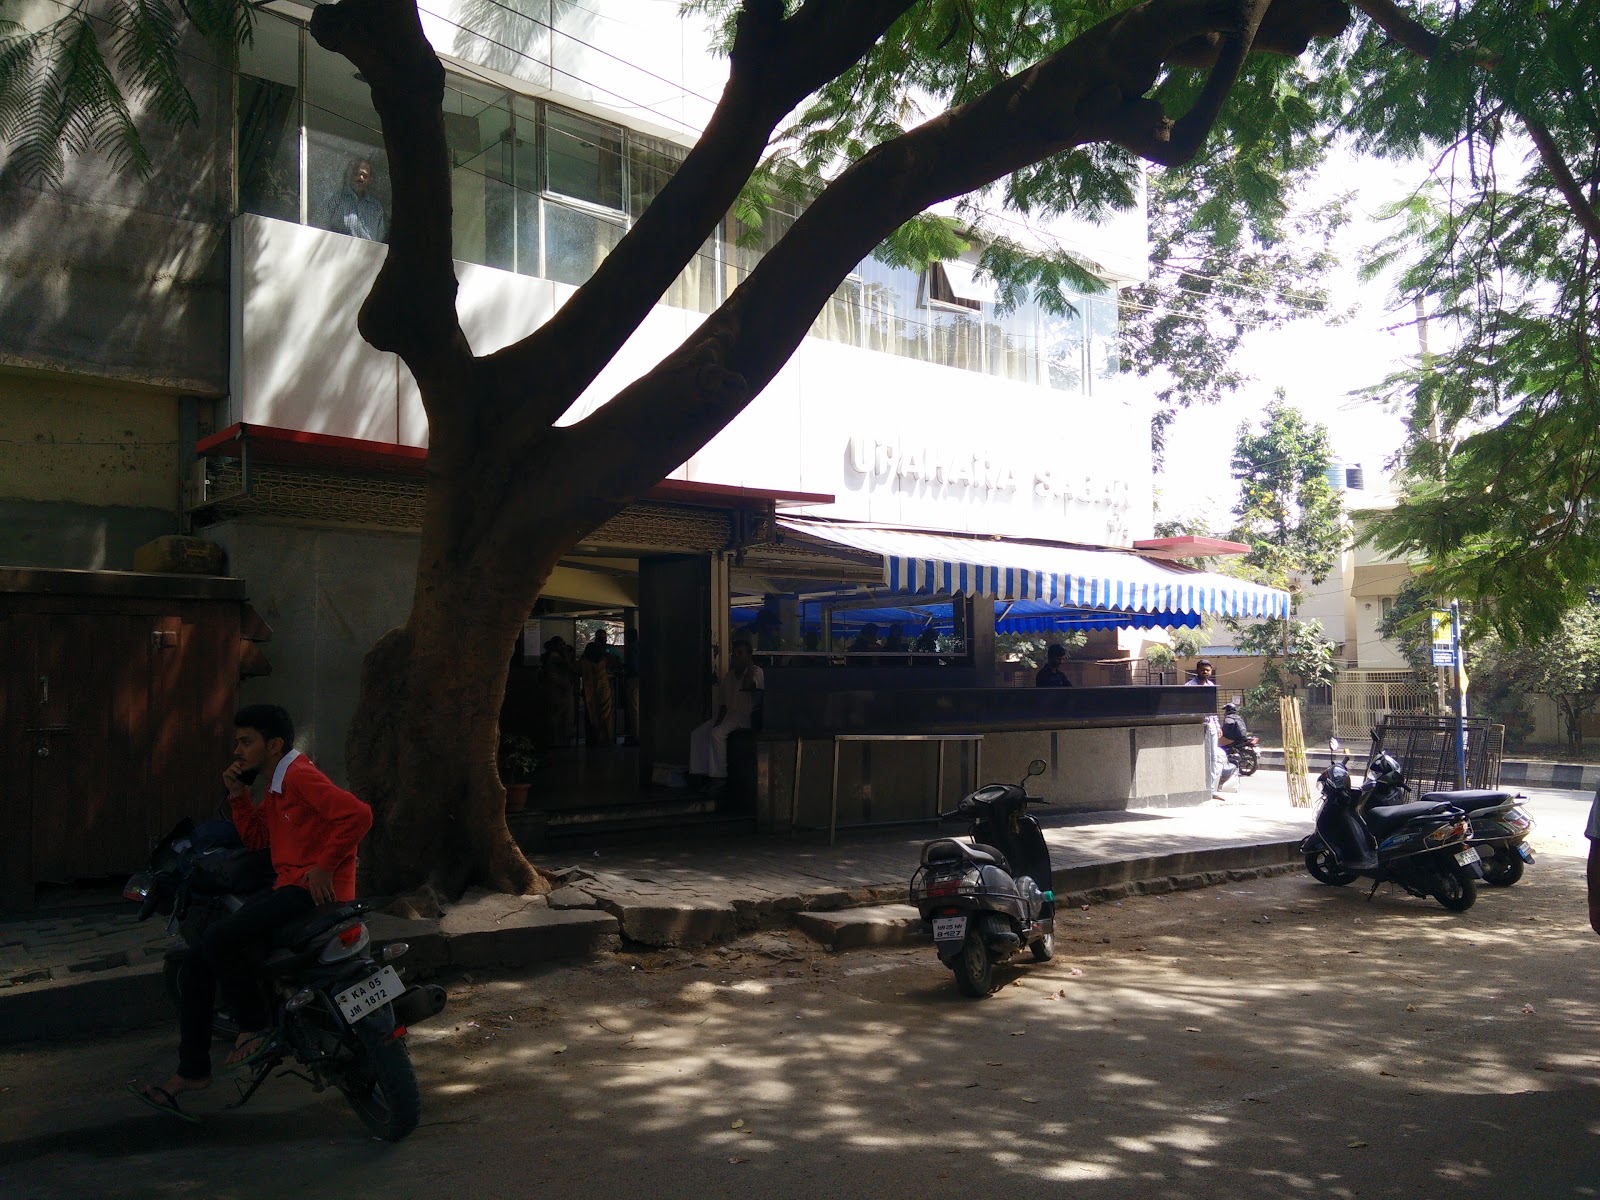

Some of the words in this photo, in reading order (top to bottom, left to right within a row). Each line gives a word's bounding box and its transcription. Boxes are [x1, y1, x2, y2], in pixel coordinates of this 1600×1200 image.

[847, 434, 1018, 496] UPAHARA
[351, 986, 367, 1000] KA
[368, 977, 382, 990] 05
[350, 1004, 363, 1018] JM
[364, 989, 388, 1007] 1872
